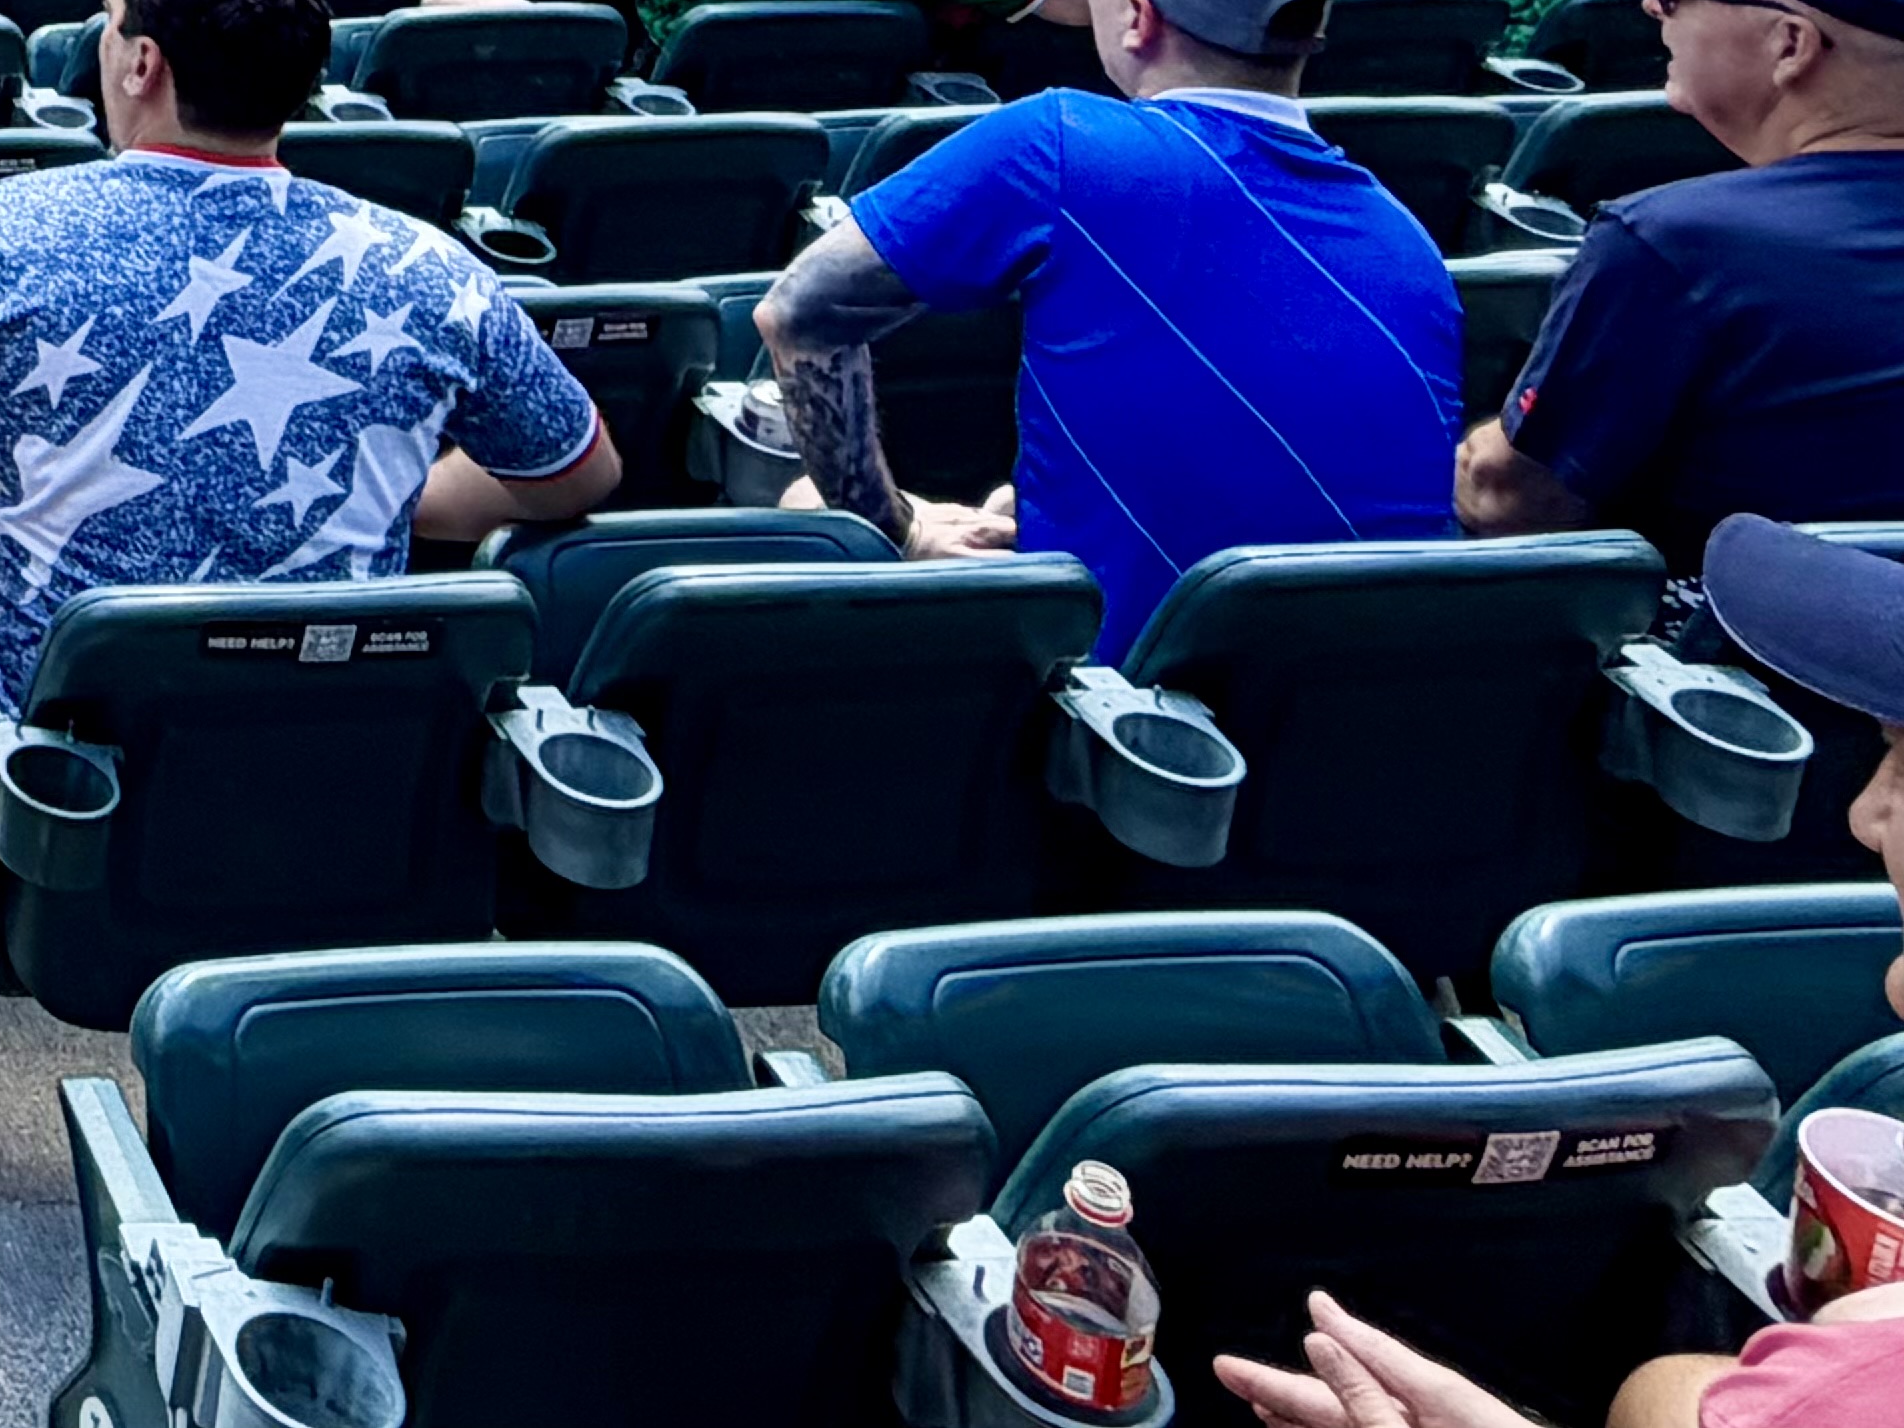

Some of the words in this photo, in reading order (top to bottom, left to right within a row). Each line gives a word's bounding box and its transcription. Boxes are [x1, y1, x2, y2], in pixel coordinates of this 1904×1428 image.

[1576, 1136, 1620, 1154] SCAN
[1622, 1132, 1655, 1149] FOR
[1343, 1153, 1402, 1169] NEED
[1405, 1152, 1472, 1169] HELP?
